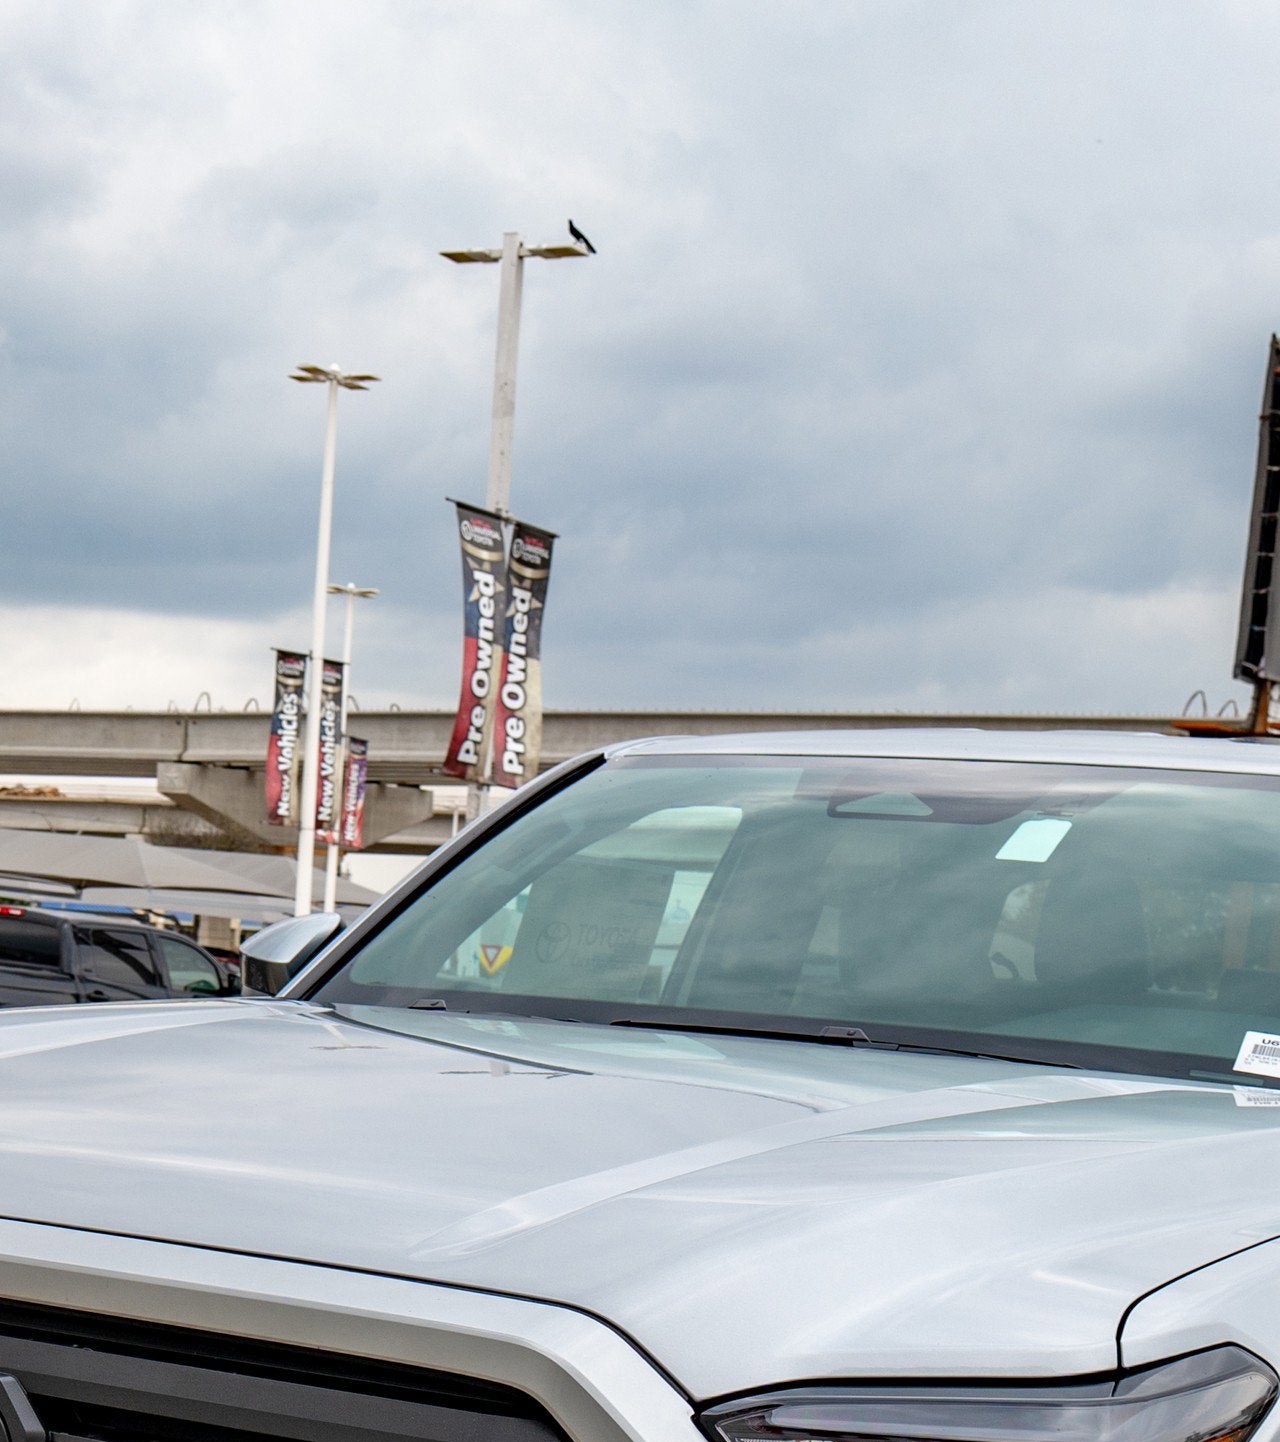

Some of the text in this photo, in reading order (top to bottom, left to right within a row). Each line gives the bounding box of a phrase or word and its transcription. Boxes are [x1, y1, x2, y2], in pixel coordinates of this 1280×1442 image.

[457, 570, 496, 766] Pre Owned
[501, 587, 533, 776] Pre Owned
[276, 692, 299, 772] Vehicles
[319, 699, 337, 778] Vehicles
[276, 773, 291, 818] New
[317, 778, 334, 822] New
